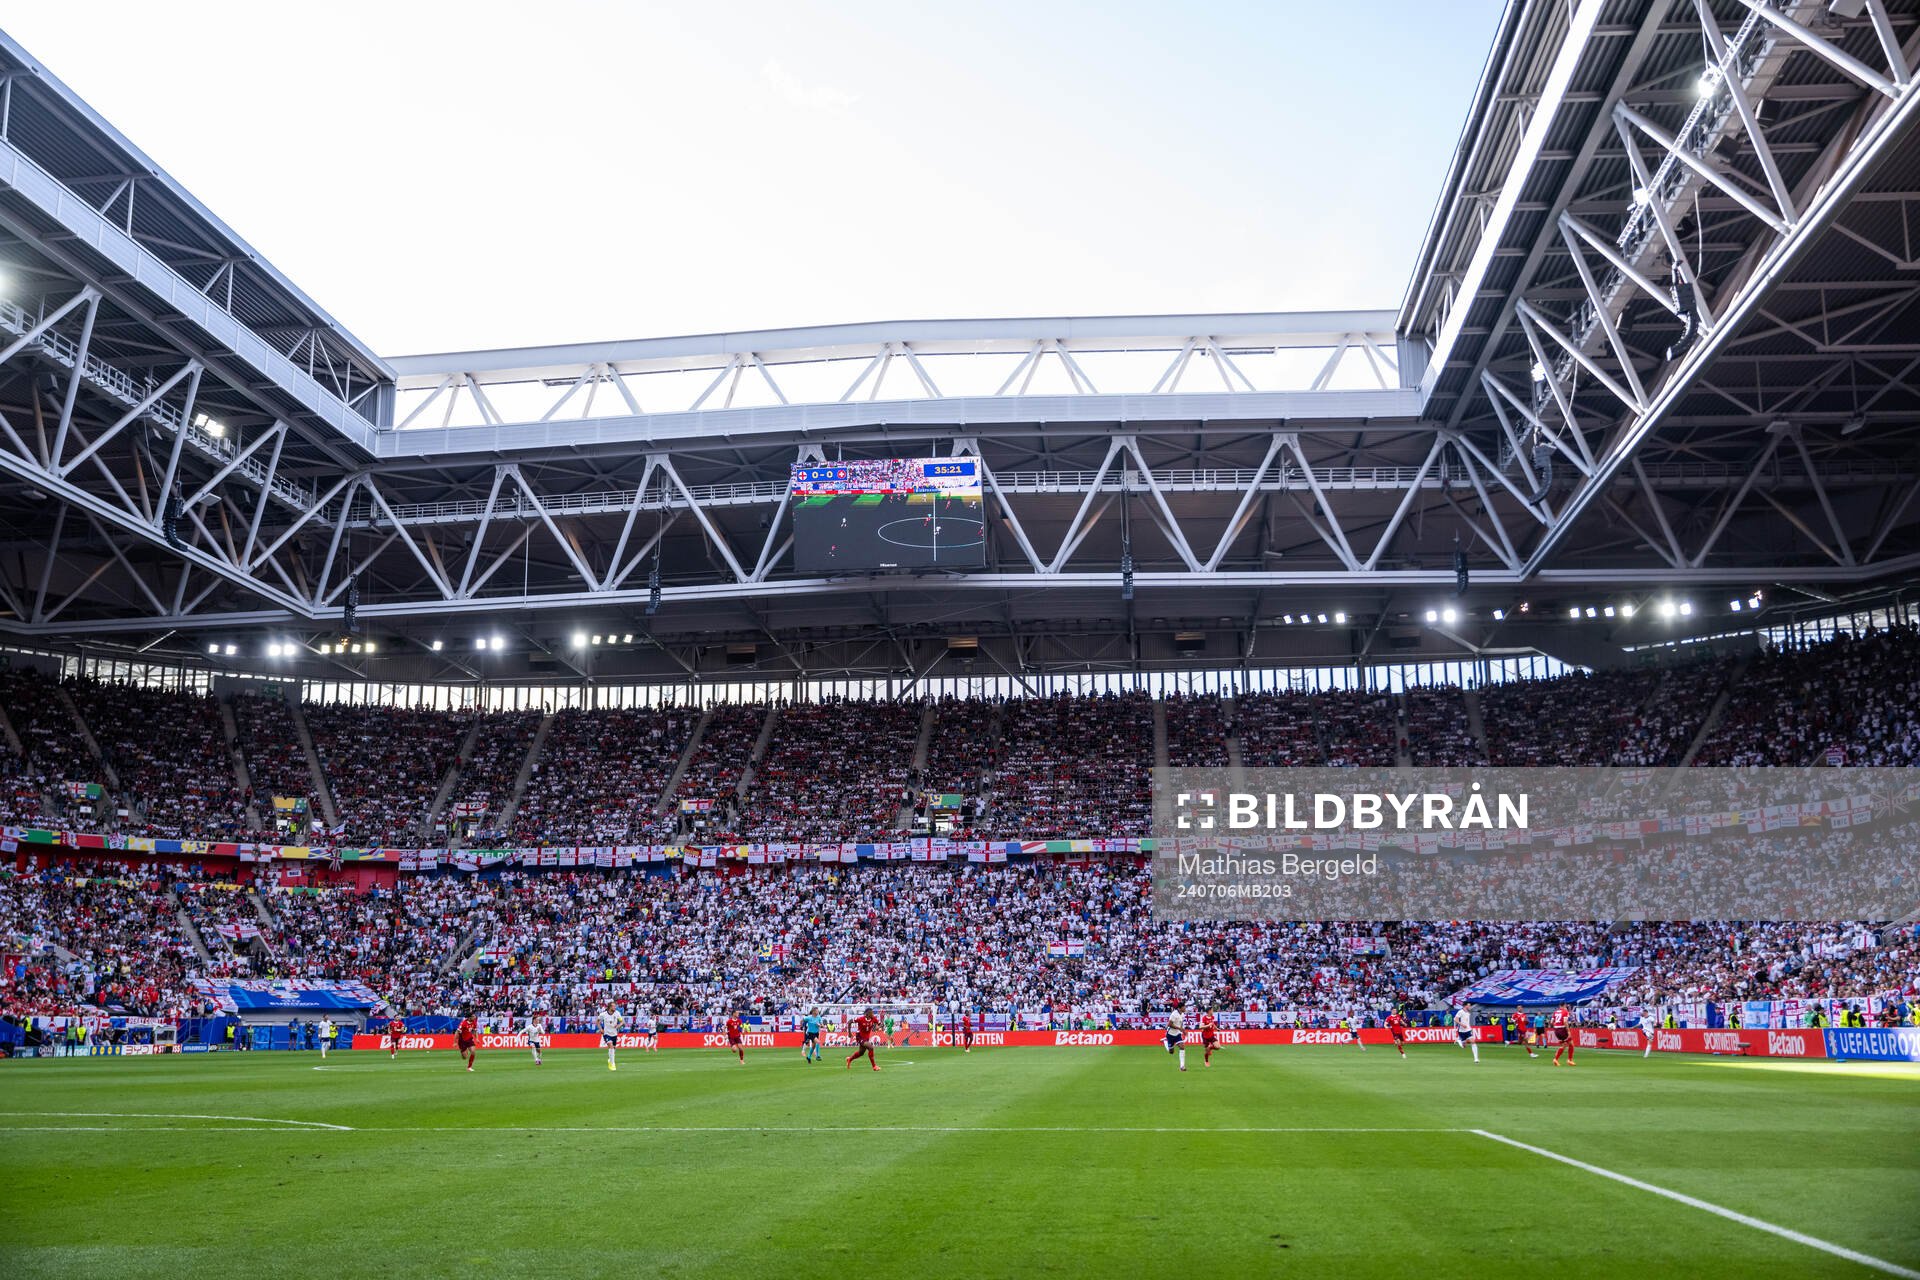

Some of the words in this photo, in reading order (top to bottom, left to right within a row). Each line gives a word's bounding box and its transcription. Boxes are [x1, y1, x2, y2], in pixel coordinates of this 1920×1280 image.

[811, 471, 819, 479] 0
[826, 470, 833, 478] 0
[934, 465, 962, 474] 35:21
[380, 1035, 434, 1049] Btano
[482, 1035, 551, 1047] SPORTWEEN
[1055, 1031, 1113, 1045] Betano
[1292, 1029, 1352, 1043] Betano
[1657, 1030, 1682, 1050] Betano
[1767, 1031, 1805, 1055] Betano
